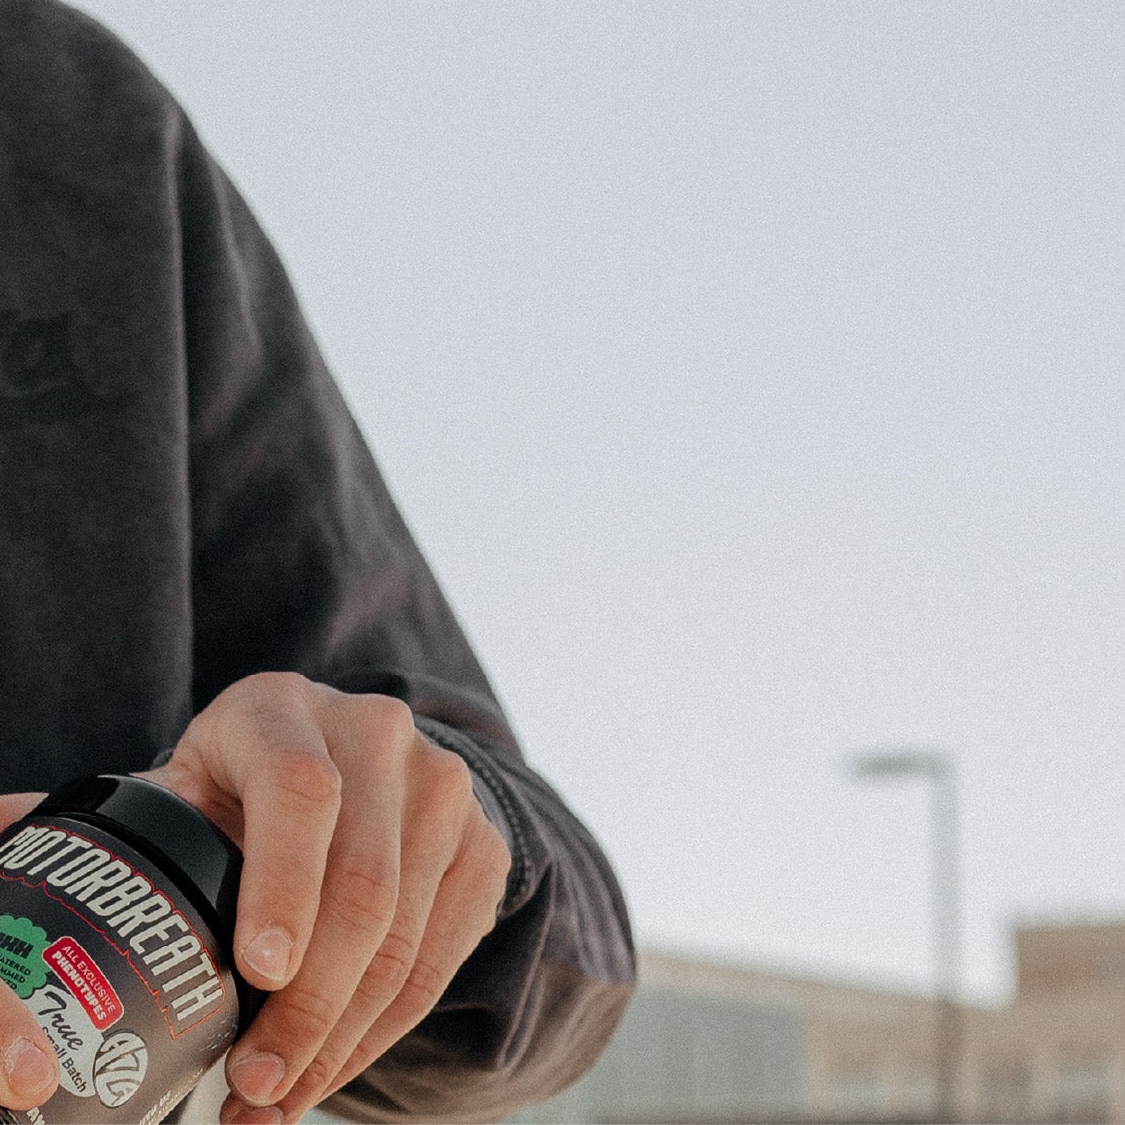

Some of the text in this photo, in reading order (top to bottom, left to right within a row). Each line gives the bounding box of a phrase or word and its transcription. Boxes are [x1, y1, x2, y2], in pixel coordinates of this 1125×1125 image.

[51, 950, 107, 1021] PHENOTYPES
[62, 945, 116, 1013] ALL EXCLUSIVE
[37, 990, 84, 1051] True
[62, 1057, 87, 1093] Batch
